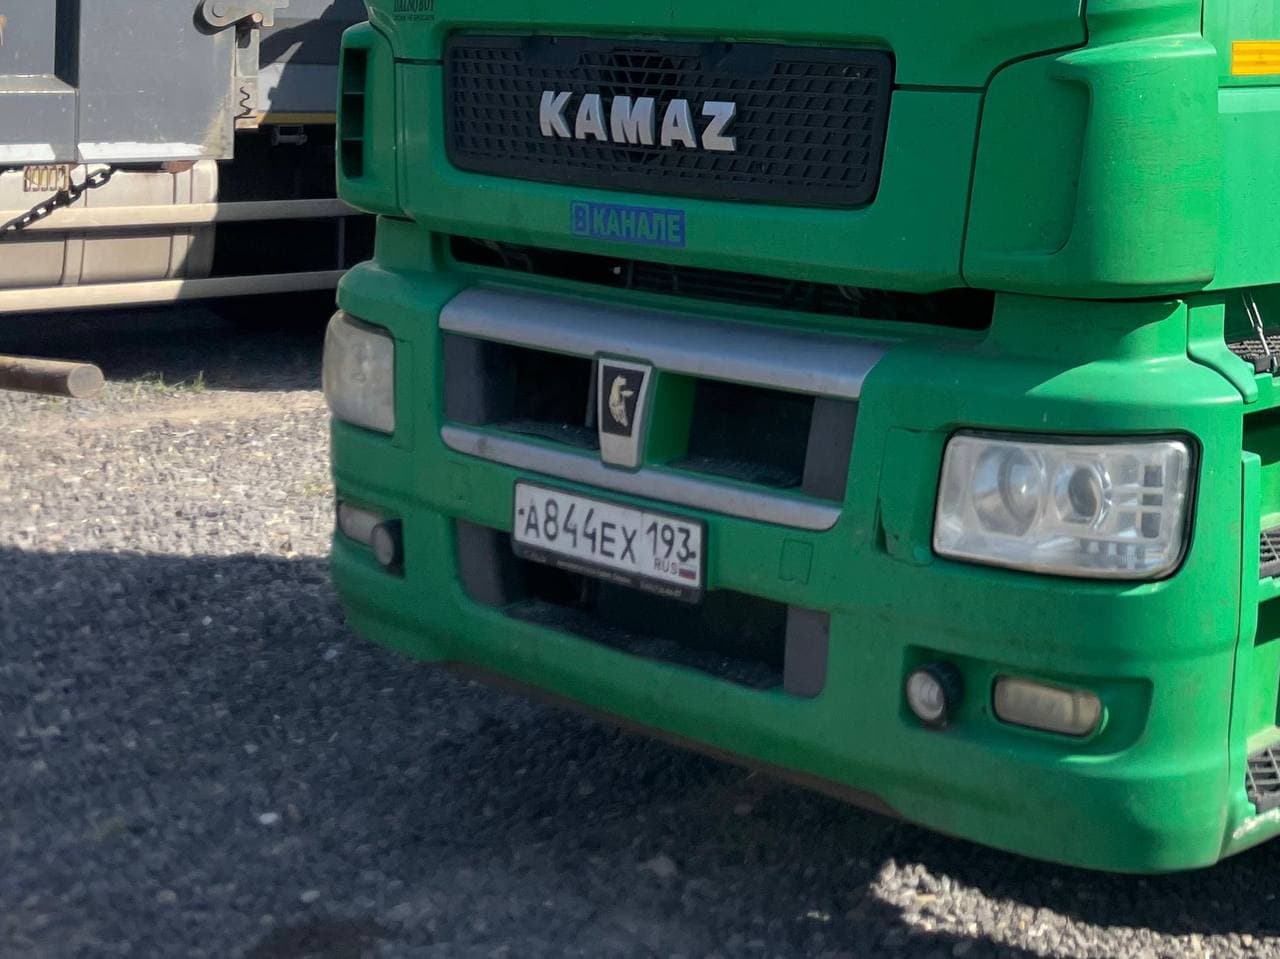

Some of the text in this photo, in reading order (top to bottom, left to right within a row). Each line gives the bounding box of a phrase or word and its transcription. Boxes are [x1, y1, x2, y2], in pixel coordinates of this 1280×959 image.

[538, 90, 738, 152] KAMAZ
[592, 207, 683, 242] КАНАЛЕ
[646, 521, 692, 562] 193
[654, 557, 679, 576] RUS
